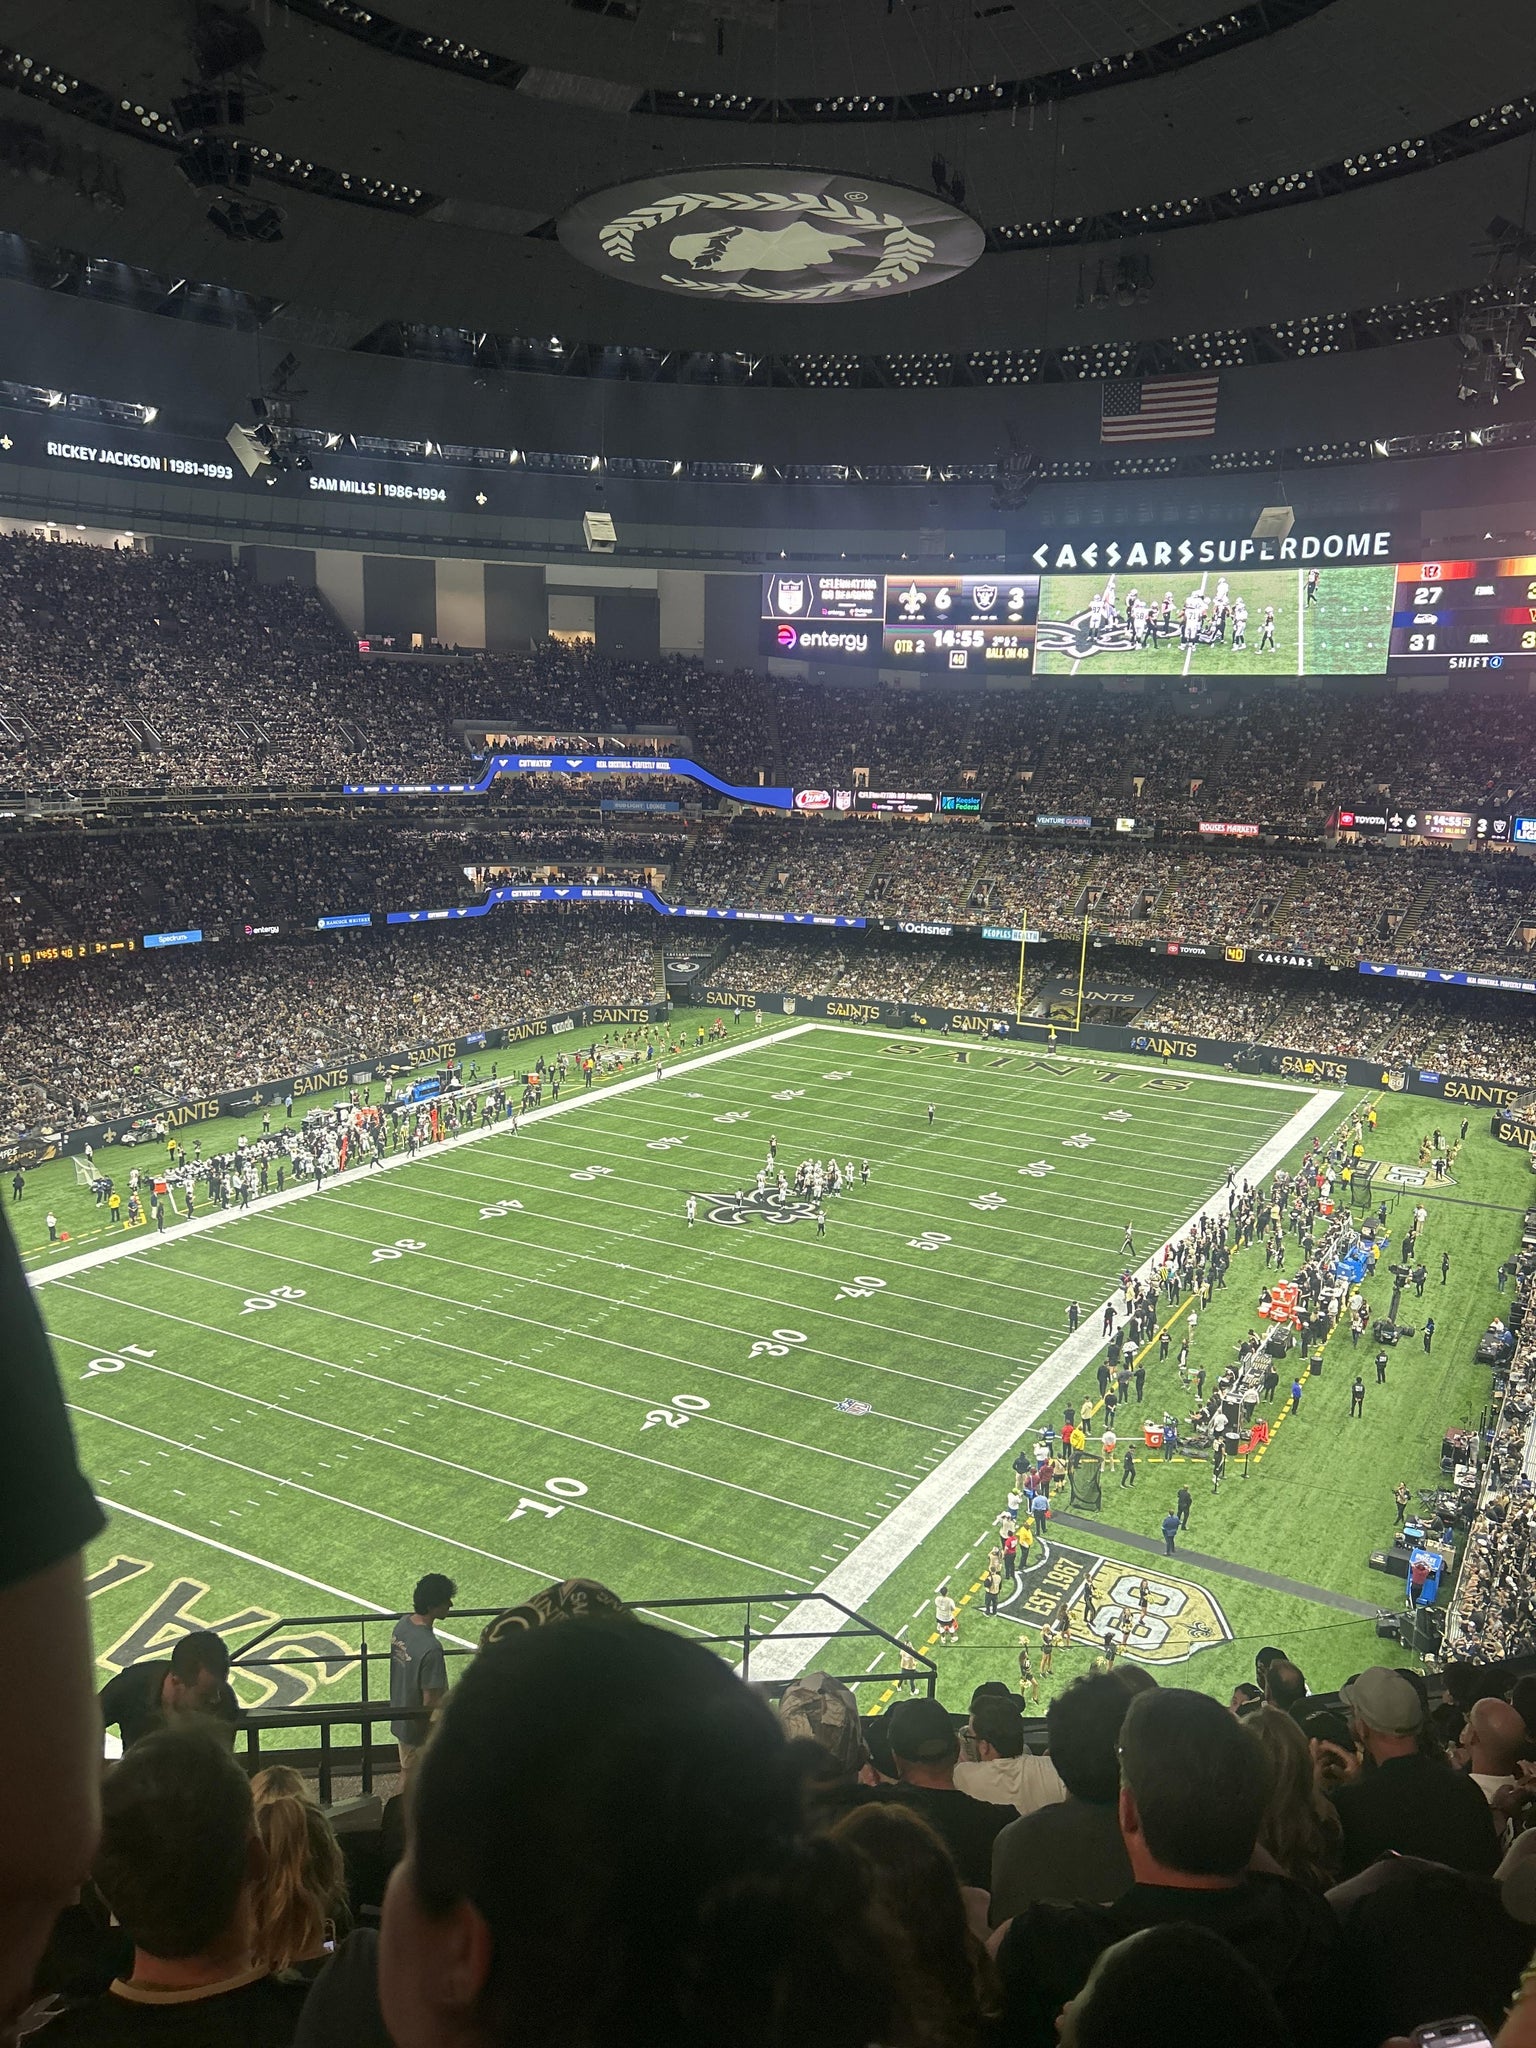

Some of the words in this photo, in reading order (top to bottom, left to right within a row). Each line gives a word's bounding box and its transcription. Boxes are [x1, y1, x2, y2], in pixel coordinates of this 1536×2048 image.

[47, 441, 97, 461] RICKEY
[99, 450, 160, 470] JACKSON
[170, 459, 233, 479] 1981-1993
[309, 477, 337, 491] SAM
[340, 480, 376, 495] MILLS
[384, 484, 447, 501] 1986-1994
[1032, 539, 1194, 568] CAESARS
[1199, 532, 1391, 563] SUPERDOME
[935, 587, 952, 610] 6
[1008, 587, 1024, 610] 3
[1413, 586, 1443, 605] 27
[800, 630, 868, 651] entergy
[933, 630, 985, 647] 14:55
[1409, 634, 1436, 651] 31
[894, 640, 913, 654] QTR
[916, 640, 925, 653] 2
[986, 648, 1004, 659] BALL
[1005, 648, 1016, 658] ON
[100, 789, 129, 797] SAINTS
[165, 787, 192, 795] SAINTS
[226, 786, 253, 794] SAINTS
[286, 785, 311, 793] SAINTS
[956, 803, 979, 811] Federal
[1037, 816, 1066, 825] VENTURE
[1164, 821, 1191, 829] SAINTS
[1355, 816, 1386, 825] TOYOTA
[1406, 814, 1417, 828] 6
[1432, 815, 1463, 827] 14:55
[1477, 819, 1487, 832] 3
[1521, 821, 1536, 831] BU
[1200, 823, 1225, 832] ROUSES
[1227, 825, 1259, 834] MARKETS
[1288, 827, 1316, 836] SAINTS
[1516, 829, 1536, 840] LIG
[204, 928, 230, 938] SAINTS
[253, 926, 279, 935] entergy
[905, 923, 952, 936] Ochsner
[983, 927, 1011, 938] PEOPLES
[158, 935, 187, 943] Spectrum
[1053, 933, 1081, 942] SAINTS
[1115, 938, 1143, 947] SAINTS
[79, 947, 85, 956] 2
[129, 941, 134, 950] 3
[1180, 947, 1206, 955] TOYOTA
[36, 948, 58, 959] 14:55
[61, 949, 73, 958] 48
[1228, 948, 1243, 960] 40
[1258, 953, 1312, 967] CAESARS
[1324, 957, 1355, 968] SAINTS
[706, 991, 756, 1008] SAINTS
[1060, 987, 1135, 1002] SAINTS
[593, 1009, 649, 1023] SAINTS
[827, 1002, 880, 1019] SAINTS
[508, 1021, 547, 1042] SAINTS
[1136, 1036, 1197, 1058] SAINTS
[411, 1043, 456, 1066] SAINTS
[879, 1043, 1195, 1092] SAINTS
[1282, 1056, 1347, 1077] SANTS
[294, 1069, 348, 1096] SAINTS
[822, 1071, 850, 1080] 10
[771, 1089, 802, 1101] 20
[1444, 1082, 1519, 1107] SAINTS
[713, 1111, 747, 1124] 30
[1101, 1109, 1131, 1122] 10
[1061, 1133, 1094, 1148] 20
[1500, 1123, 1536, 1146] SAI
[646, 1136, 685, 1150] 40
[569, 1165, 615, 1181] 50
[1017, 1160, 1053, 1177] 30
[968, 1192, 1004, 1211] 40
[482, 1200, 524, 1218] 40
[907, 1232, 952, 1251] 50
[372, 1239, 426, 1260] 30
[839, 1276, 887, 1299] 40
[243, 1285, 307, 1311] 20
[751, 1329, 808, 1357] 30
[87, 1344, 157, 1375] 10
[646, 1394, 711, 1429] 20
[1151, 1435, 1160, 1444] G
[519, 1477, 588, 1519] 10
[1023, 1586, 1061, 1617] EST.
[1043, 1557, 1084, 1592] 1967
